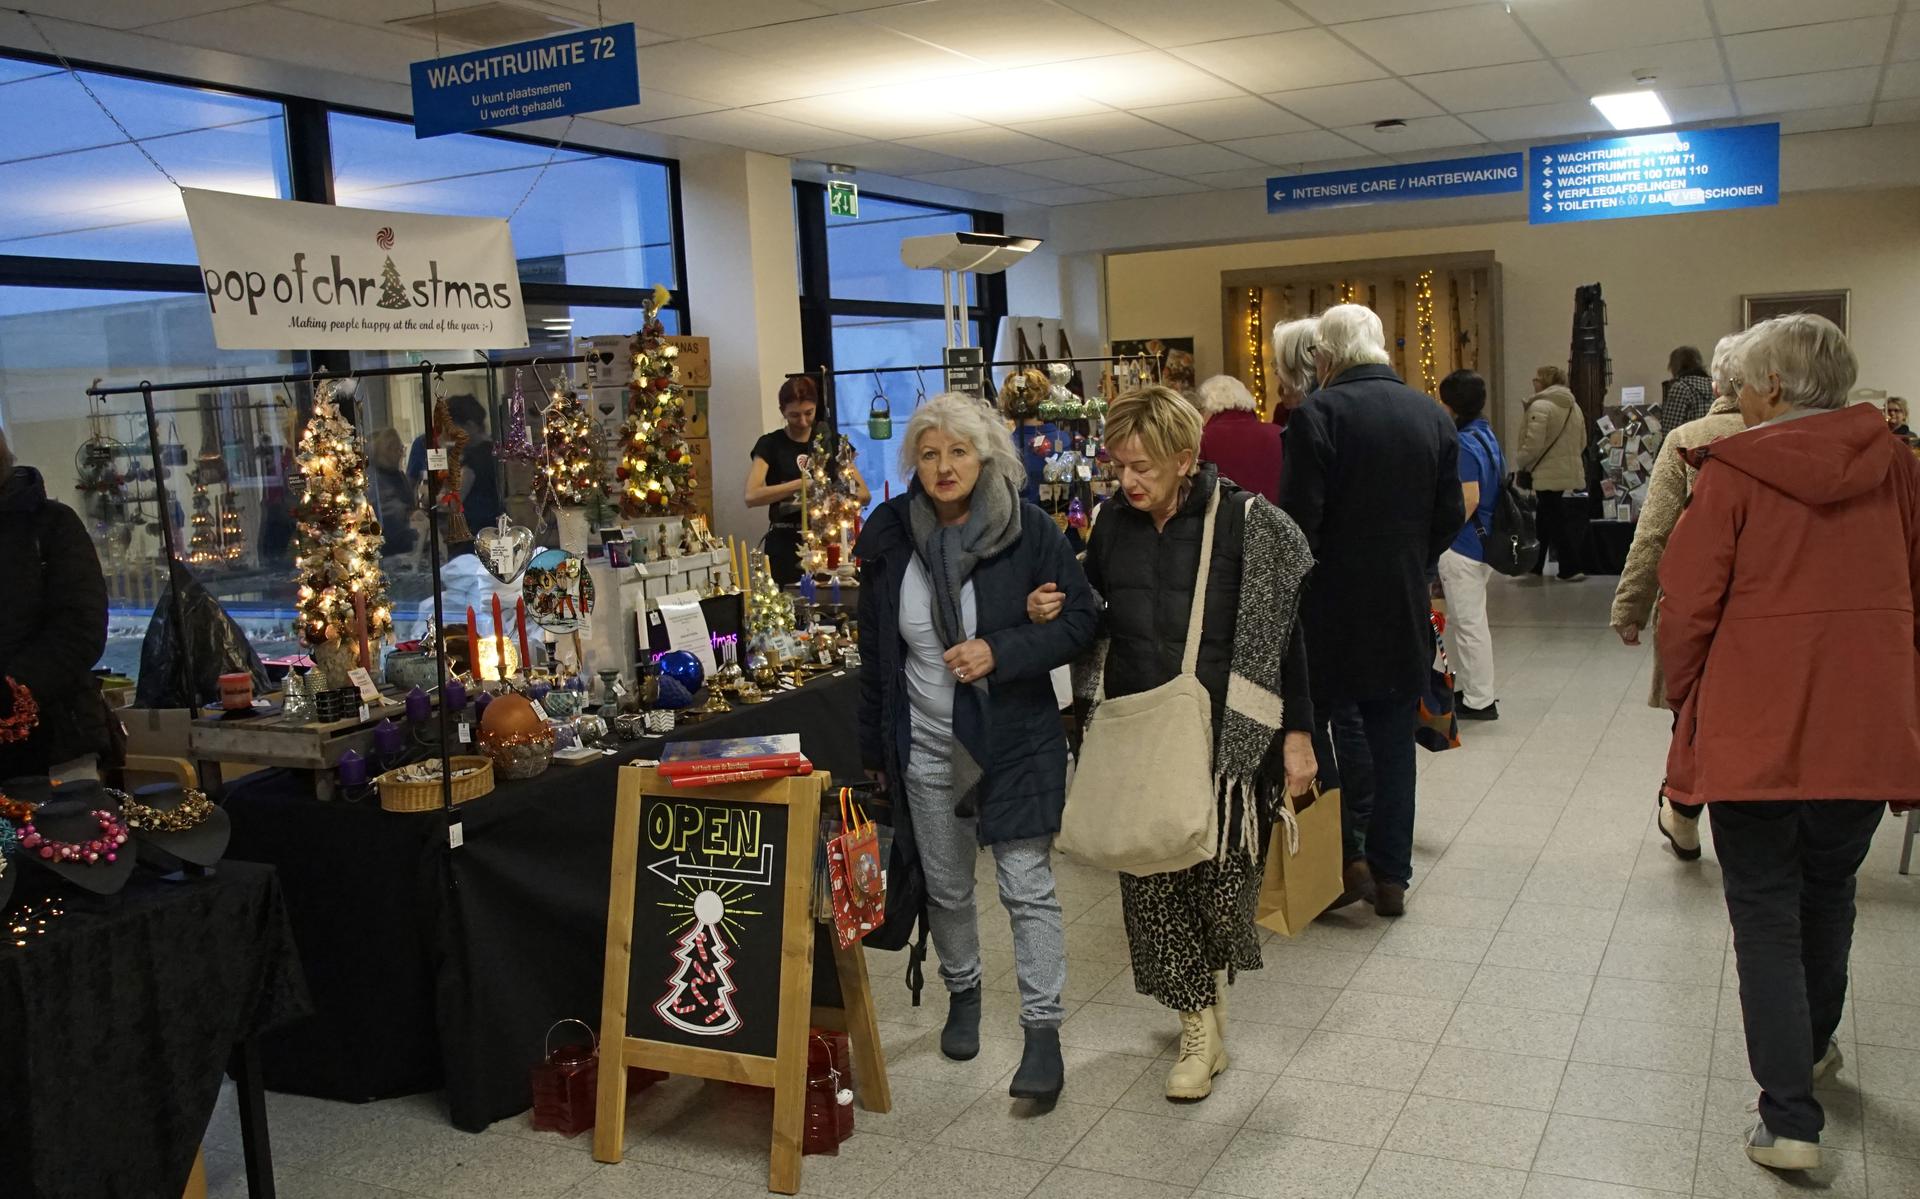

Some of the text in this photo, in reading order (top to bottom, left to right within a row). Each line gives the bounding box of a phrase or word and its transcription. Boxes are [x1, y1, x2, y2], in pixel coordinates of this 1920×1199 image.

[428, 36, 616, 89] WACHTRUIMTE 72
[472, 81, 571, 106] U kunt plaatsnemen
[480, 98, 565, 120] U wordt gehaald.
[1557, 146, 1641, 164] WACHTRUIMTE
[1676, 142, 1690, 151] 39
[1557, 154, 1695, 175] WACHTRUIMTE 41 T/M 71
[1292, 167, 1518, 199] INTENSIVE CARE / HARTBEWAKING
[1557, 165, 1709, 188] WACHTRUIMTE 100 T/M 110
[1557, 179, 1687, 200] VERPLEEGAFDELINGEN
[1557, 185, 1763, 212] TOILETTEN / BABY VERSCHONEN
[203, 268, 266, 316] pop
[273, 252, 308, 305] of
[288, 315, 327, 331] Making
[330, 316, 359, 333] people
[361, 316, 390, 333] happy
[393, 319, 403, 330] at
[404, 318, 417, 330] the
[419, 318, 434, 330] end
[436, 317, 446, 332] of
[447, 318, 460, 330] the
[461, 321, 480, 333] year
[671, 341, 699, 354] ANAS
[647, 802, 761, 858] OPEN
